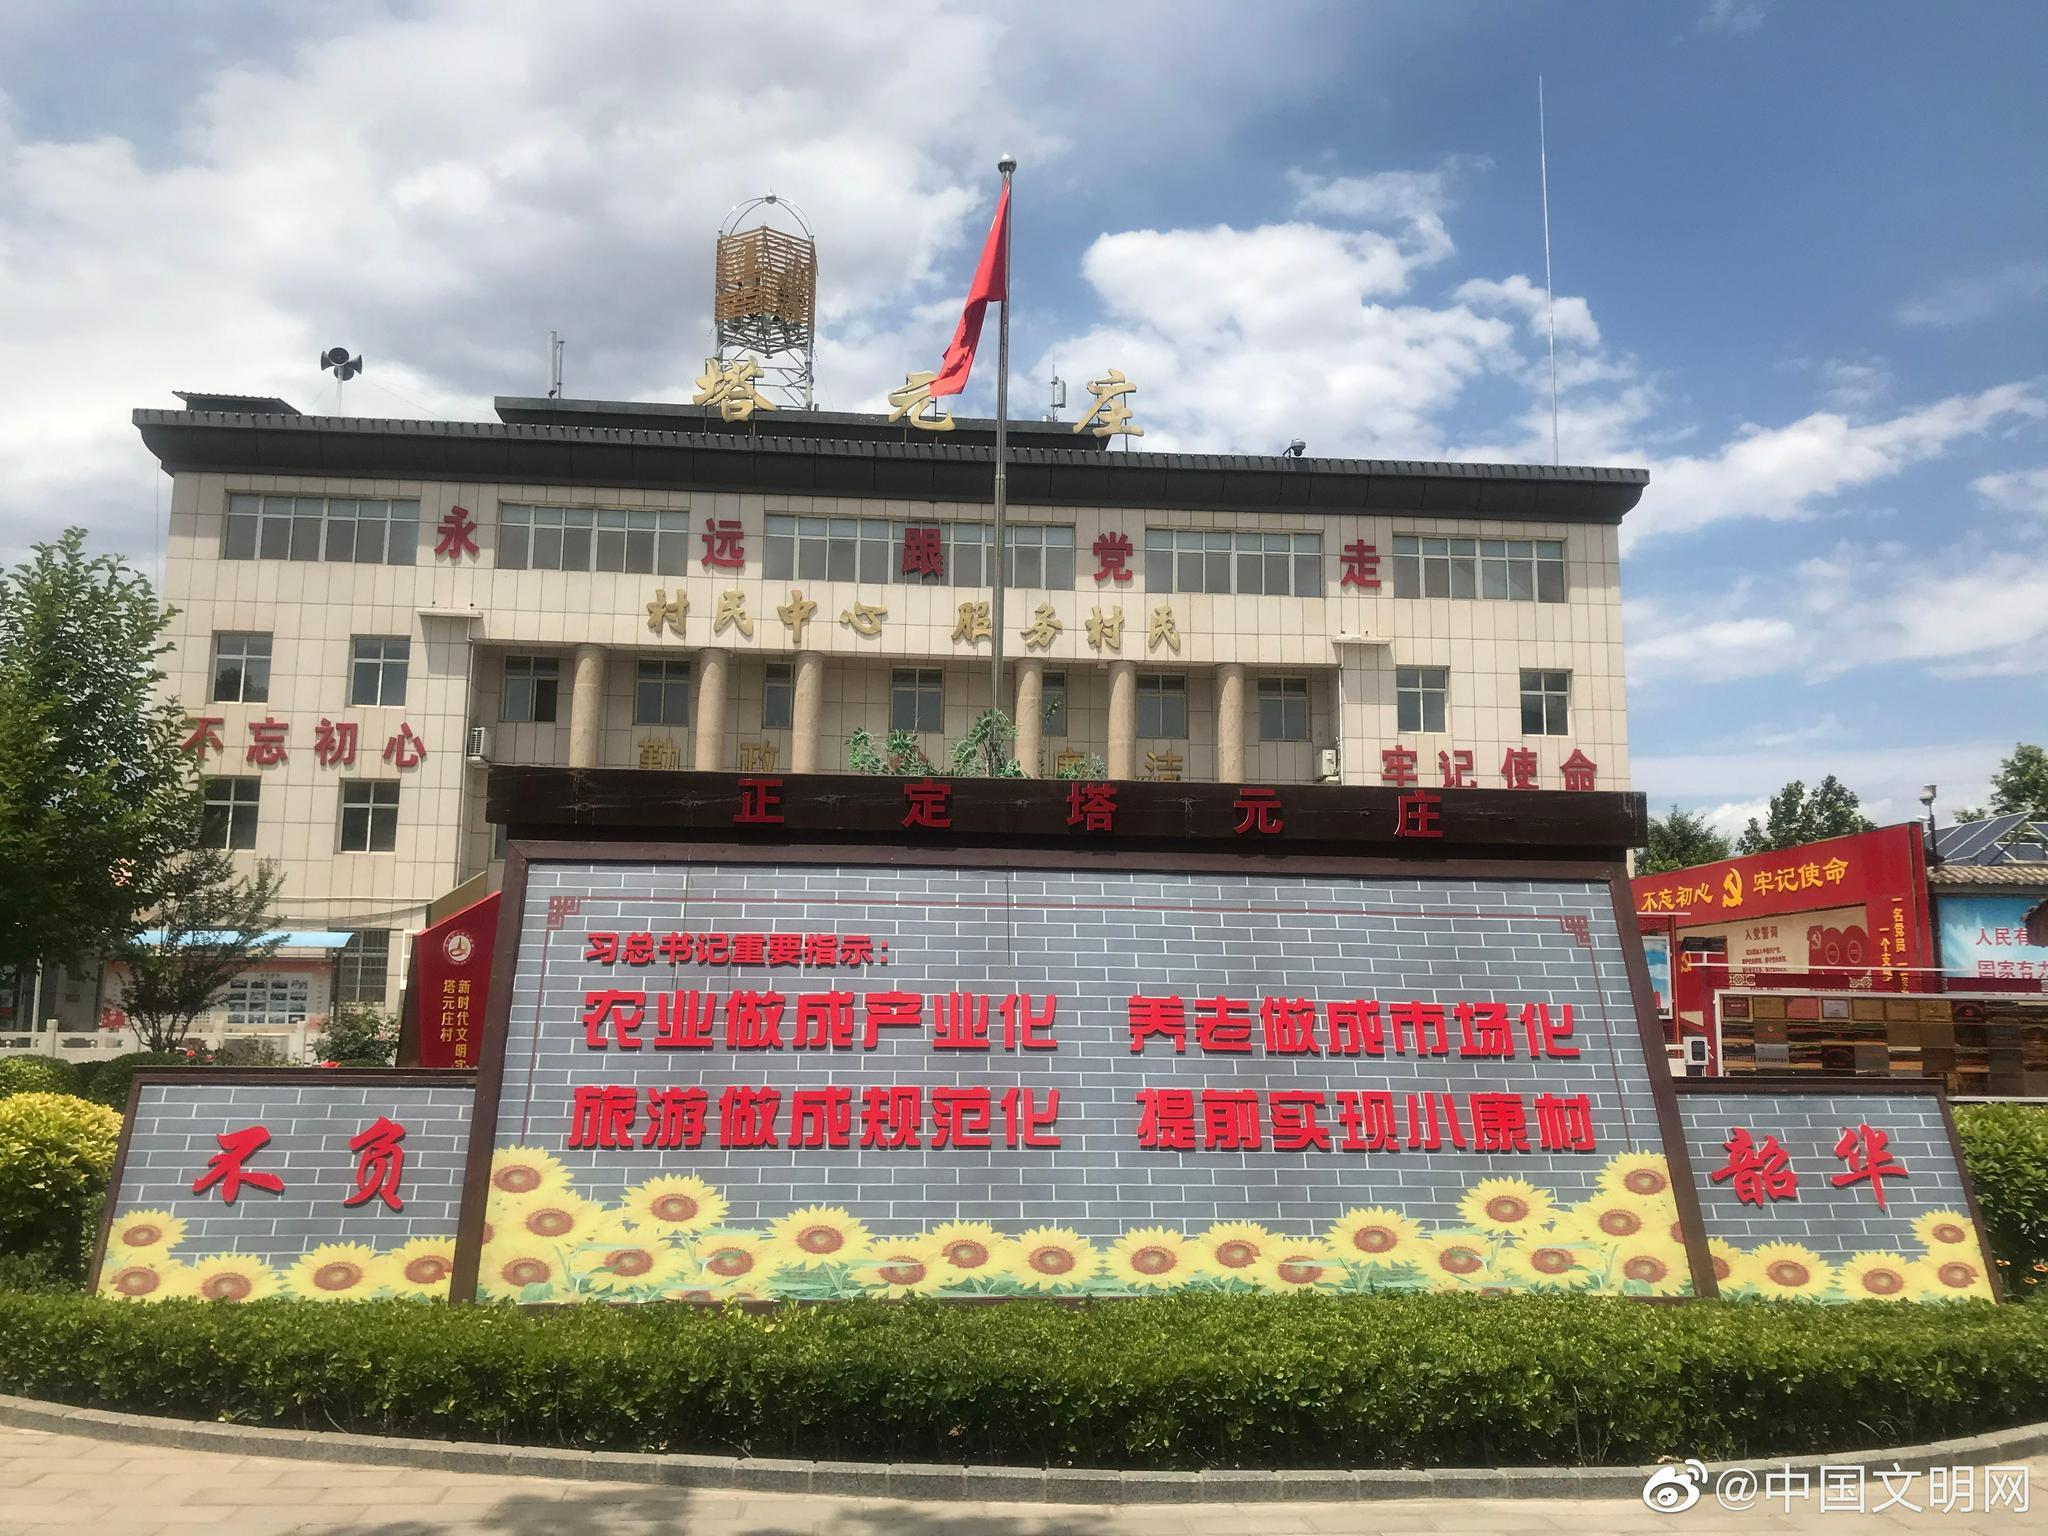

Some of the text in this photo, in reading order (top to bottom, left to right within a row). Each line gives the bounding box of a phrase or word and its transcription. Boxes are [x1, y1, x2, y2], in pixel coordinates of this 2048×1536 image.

[693, 355, 1144, 438] 塔元庄
[434, 505, 1382, 589] 永远跟党走
[646, 588, 1182, 652] 村民中心 服务村民
[180, 717, 427, 768] 不忘初心
[1381, 745, 1598, 791] 牢记使命
[732, 778, 1444, 839] 正定塔元庄
[1641, 857, 1849, 912] 不忘初心 牢记使命
[440, 978, 456, 1042] 塔元庄村
[582, 989, 1581, 1059] 农业做成产业化 养老做成市场化
[568, 1085, 1598, 1152] 旅游做成规范化 提前实现小康村
[192, 1115, 406, 1212] 不负
[1711, 1124, 1909, 1212] 韶华
